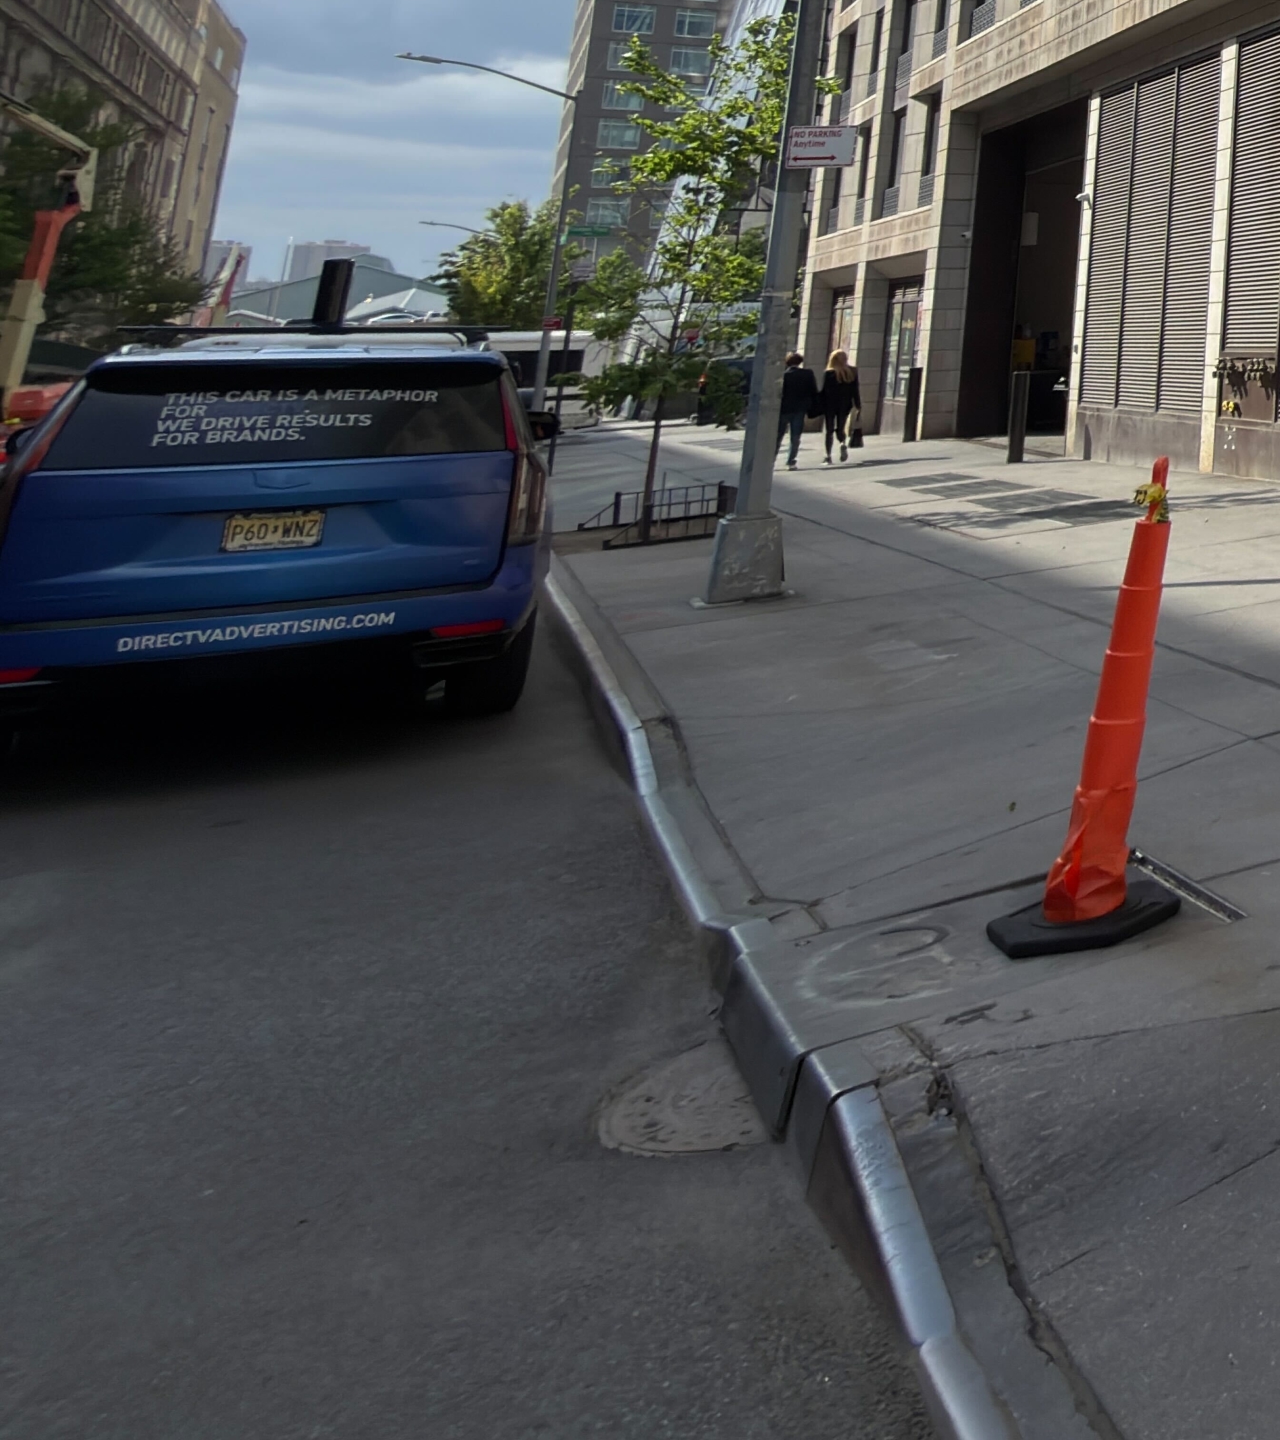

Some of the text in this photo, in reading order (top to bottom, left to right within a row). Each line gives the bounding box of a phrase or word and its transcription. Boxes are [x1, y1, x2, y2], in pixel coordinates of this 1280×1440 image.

[808, 130, 842, 138] PARKING
[793, 140, 826, 149] Anytime
[165, 389, 439, 404] THIS CAR IS A METAPHOR
[160, 405, 207, 419] FOR
[156, 414, 372, 432] WE DRIVE RESULTS
[151, 428, 306, 447] FOR BRANDS.
[117, 612, 396, 652] DIRECTVADVERTISING.COM
